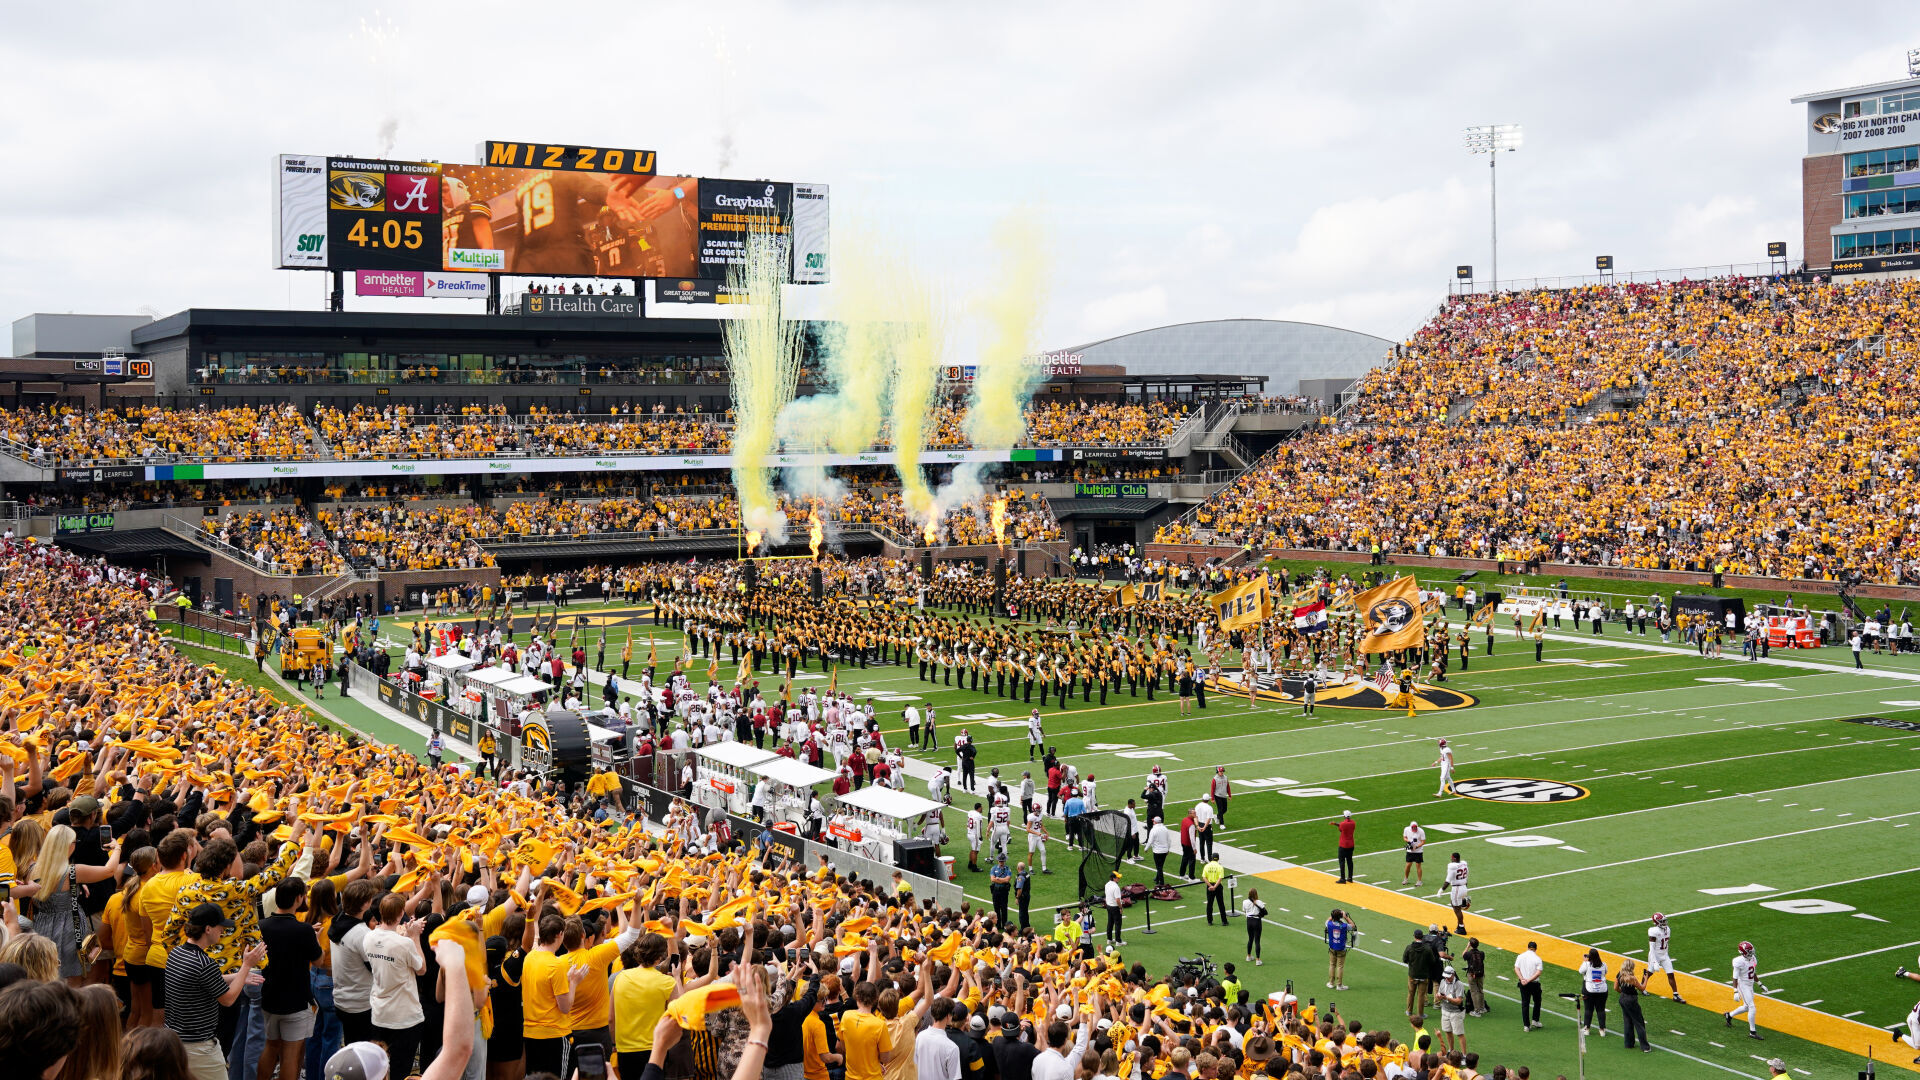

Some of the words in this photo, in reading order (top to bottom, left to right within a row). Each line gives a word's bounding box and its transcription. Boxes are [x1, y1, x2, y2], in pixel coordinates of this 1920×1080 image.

[1871, 116, 1898, 126] NORTH
[1901, 112, 1920, 122] CHA
[1843, 131, 1862, 140] 2007
[1865, 128, 1884, 137] 2008
[1888, 125, 1905, 134] 2010
[490, 143, 655, 172] MIZZOU
[331, 162, 386, 170] COUNTDOWN
[402, 165, 438, 173] KICKOFF
[394, 176, 429, 211] A
[712, 214, 767, 224] INTERESTED
[769, 216, 780, 224] IN
[348, 218, 423, 249] 4:05
[701, 222, 745, 232] PREMIUM
[297, 234, 324, 252] SOY
[453, 250, 498, 267] Multipli
[805, 253, 826, 268] SOY
[364, 273, 416, 286] ambetter
[437, 280, 485, 290] BreakTime
[550, 298, 598, 312] Health
[601, 299, 633, 313] Care
[132, 362, 148, 375] 40
[66, 470, 90, 479] brightspeed
[1076, 484, 1116, 497] Multipli
[1122, 485, 1146, 494] Club
[90, 515, 114, 527] Club
[792, 713, 800, 722] 10
[836, 734, 844, 742] 81
[523, 748, 535, 761] BIG
[536, 751, 549, 765] MO
[996, 812, 1008, 823] 52
[1423, 821, 1564, 847] 20
[1456, 868, 1468, 880] 22
[367, 953, 394, 962] VOLUNTEER
